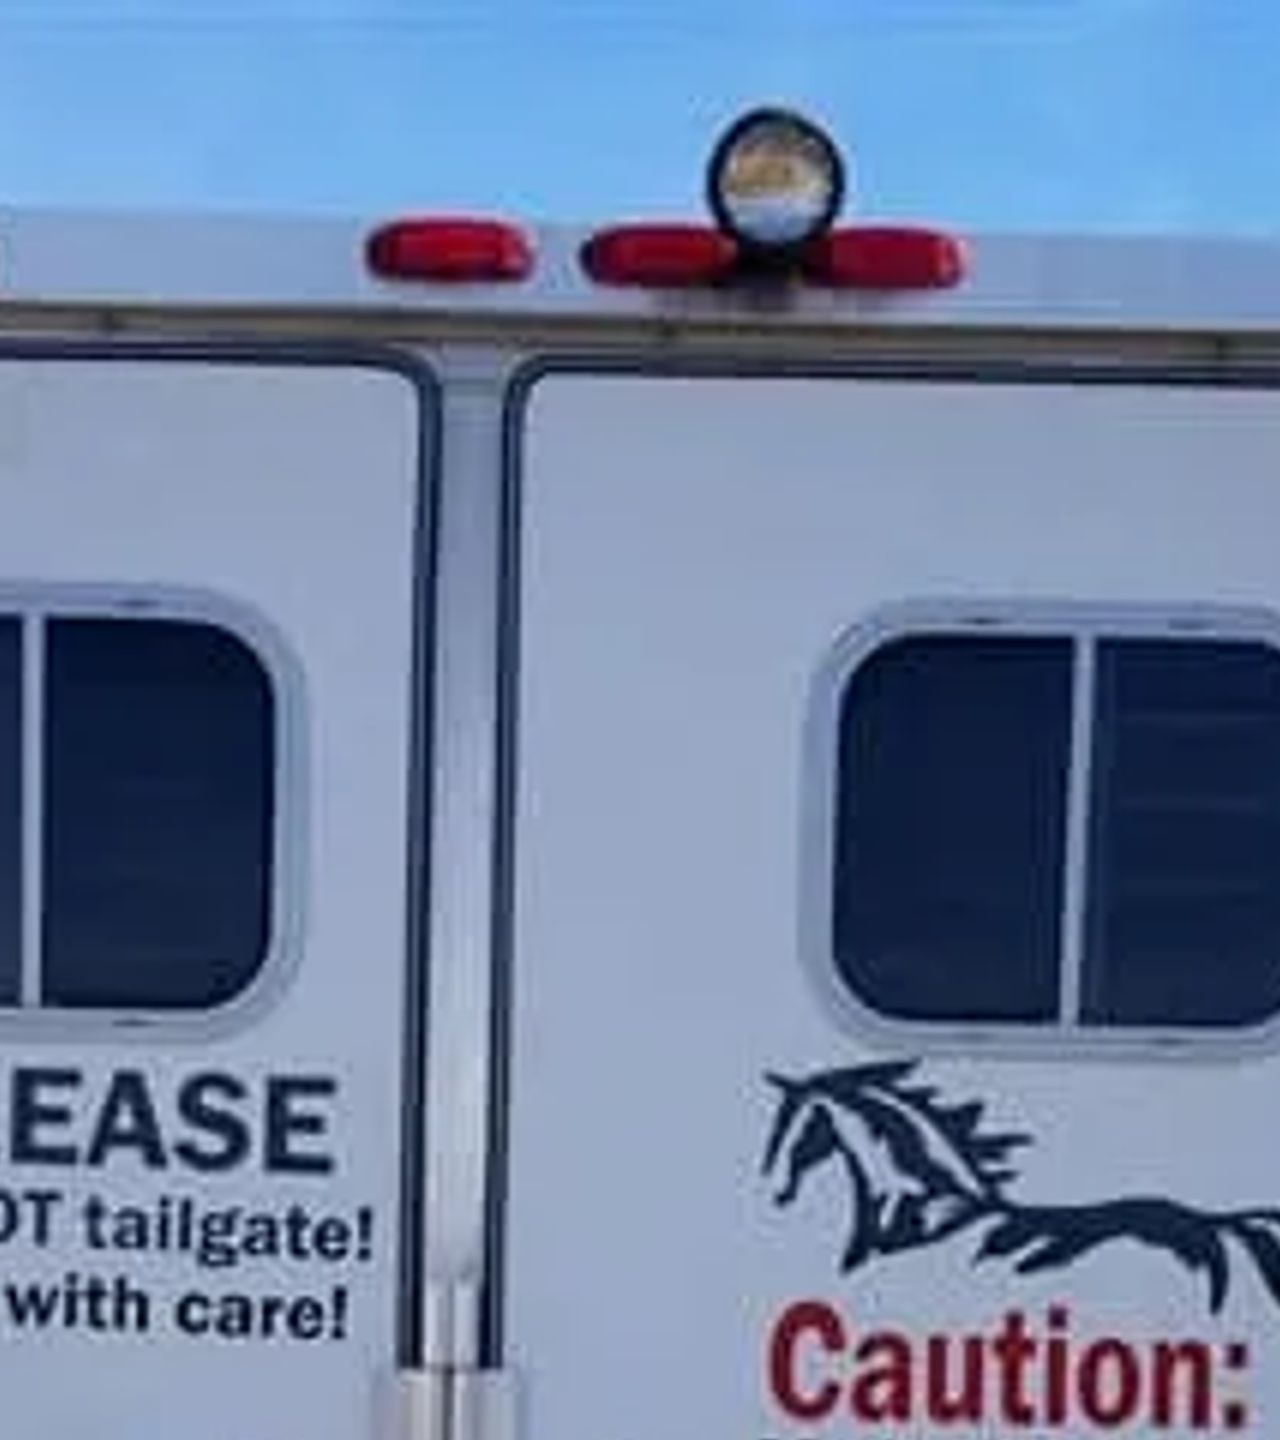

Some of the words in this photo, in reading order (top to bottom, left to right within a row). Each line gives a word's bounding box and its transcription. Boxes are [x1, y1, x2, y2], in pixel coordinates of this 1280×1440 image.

[84, 1197, 376, 1267] tailgate!
[4, 1274, 150, 1332] with
[174, 1287, 348, 1339] care!
[768, 1299, 1248, 1429] Caution:
